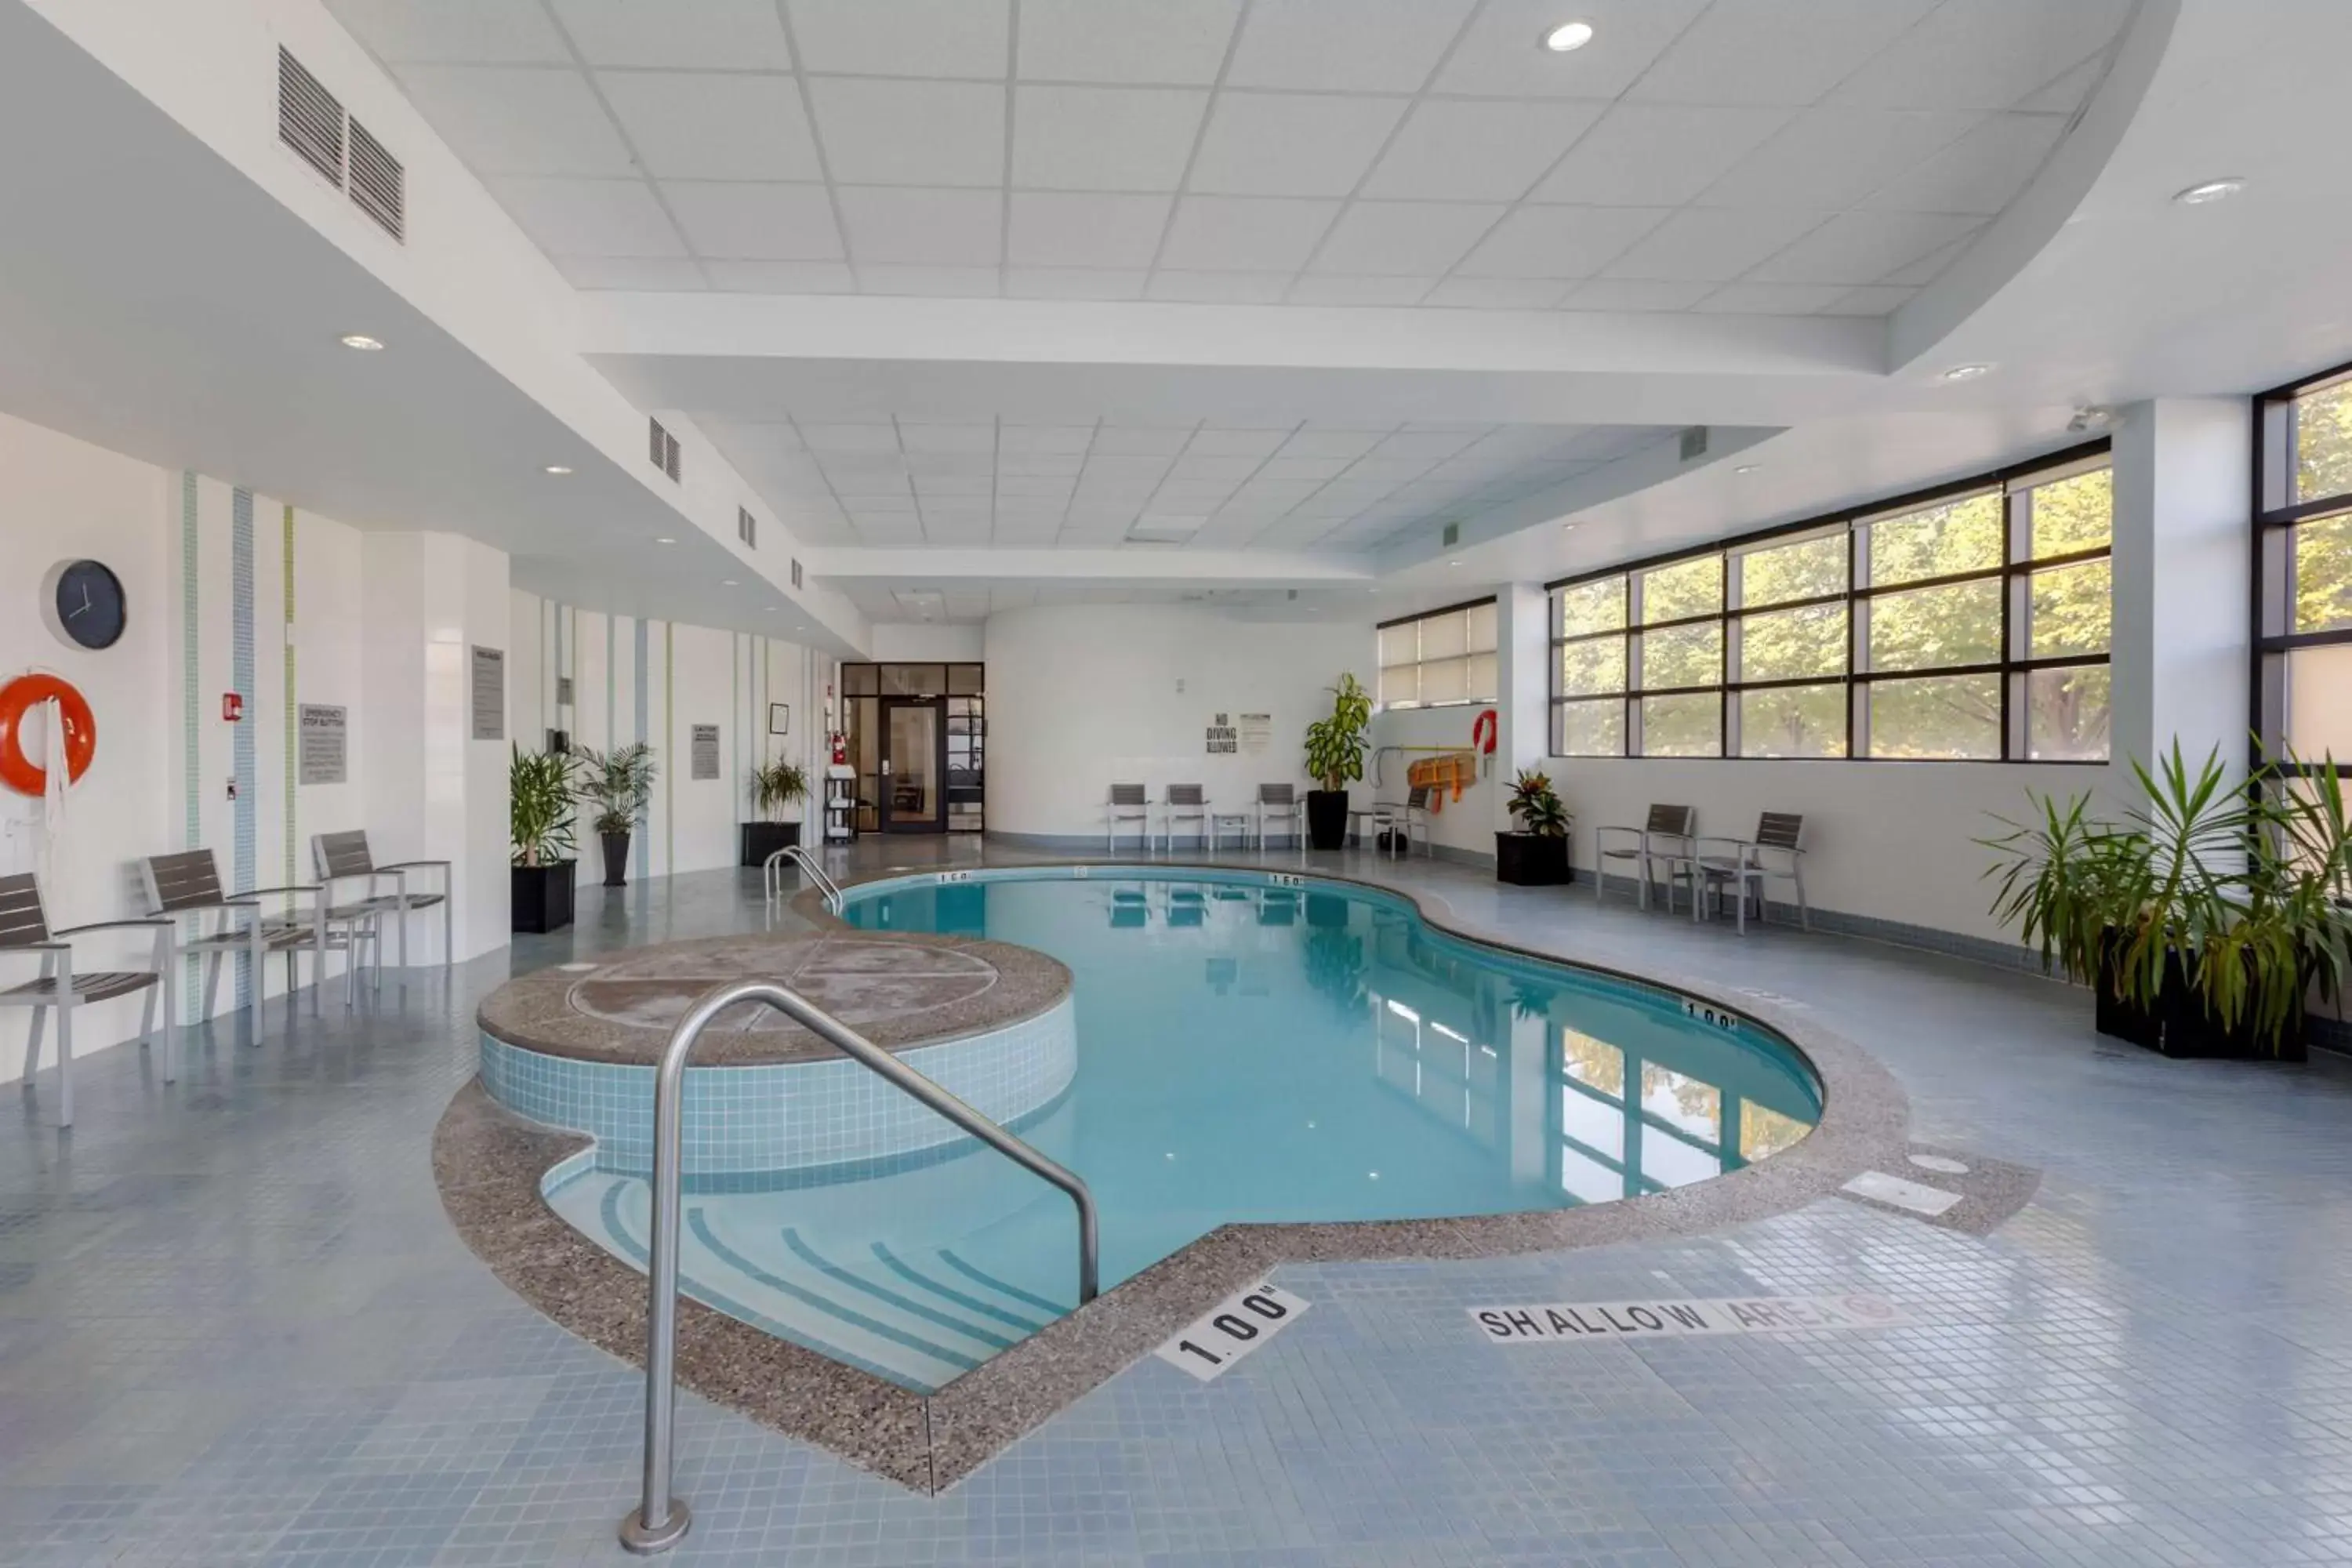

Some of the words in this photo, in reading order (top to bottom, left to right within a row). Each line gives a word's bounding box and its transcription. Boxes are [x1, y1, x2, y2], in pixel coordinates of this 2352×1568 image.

[1207, 727, 1236, 740] DIVING
[1207, 741, 1237, 753] ALLOWED
[1478, 1303, 1710, 1337] SHALLOW
[1726, 1301, 1852, 1327] AREA
